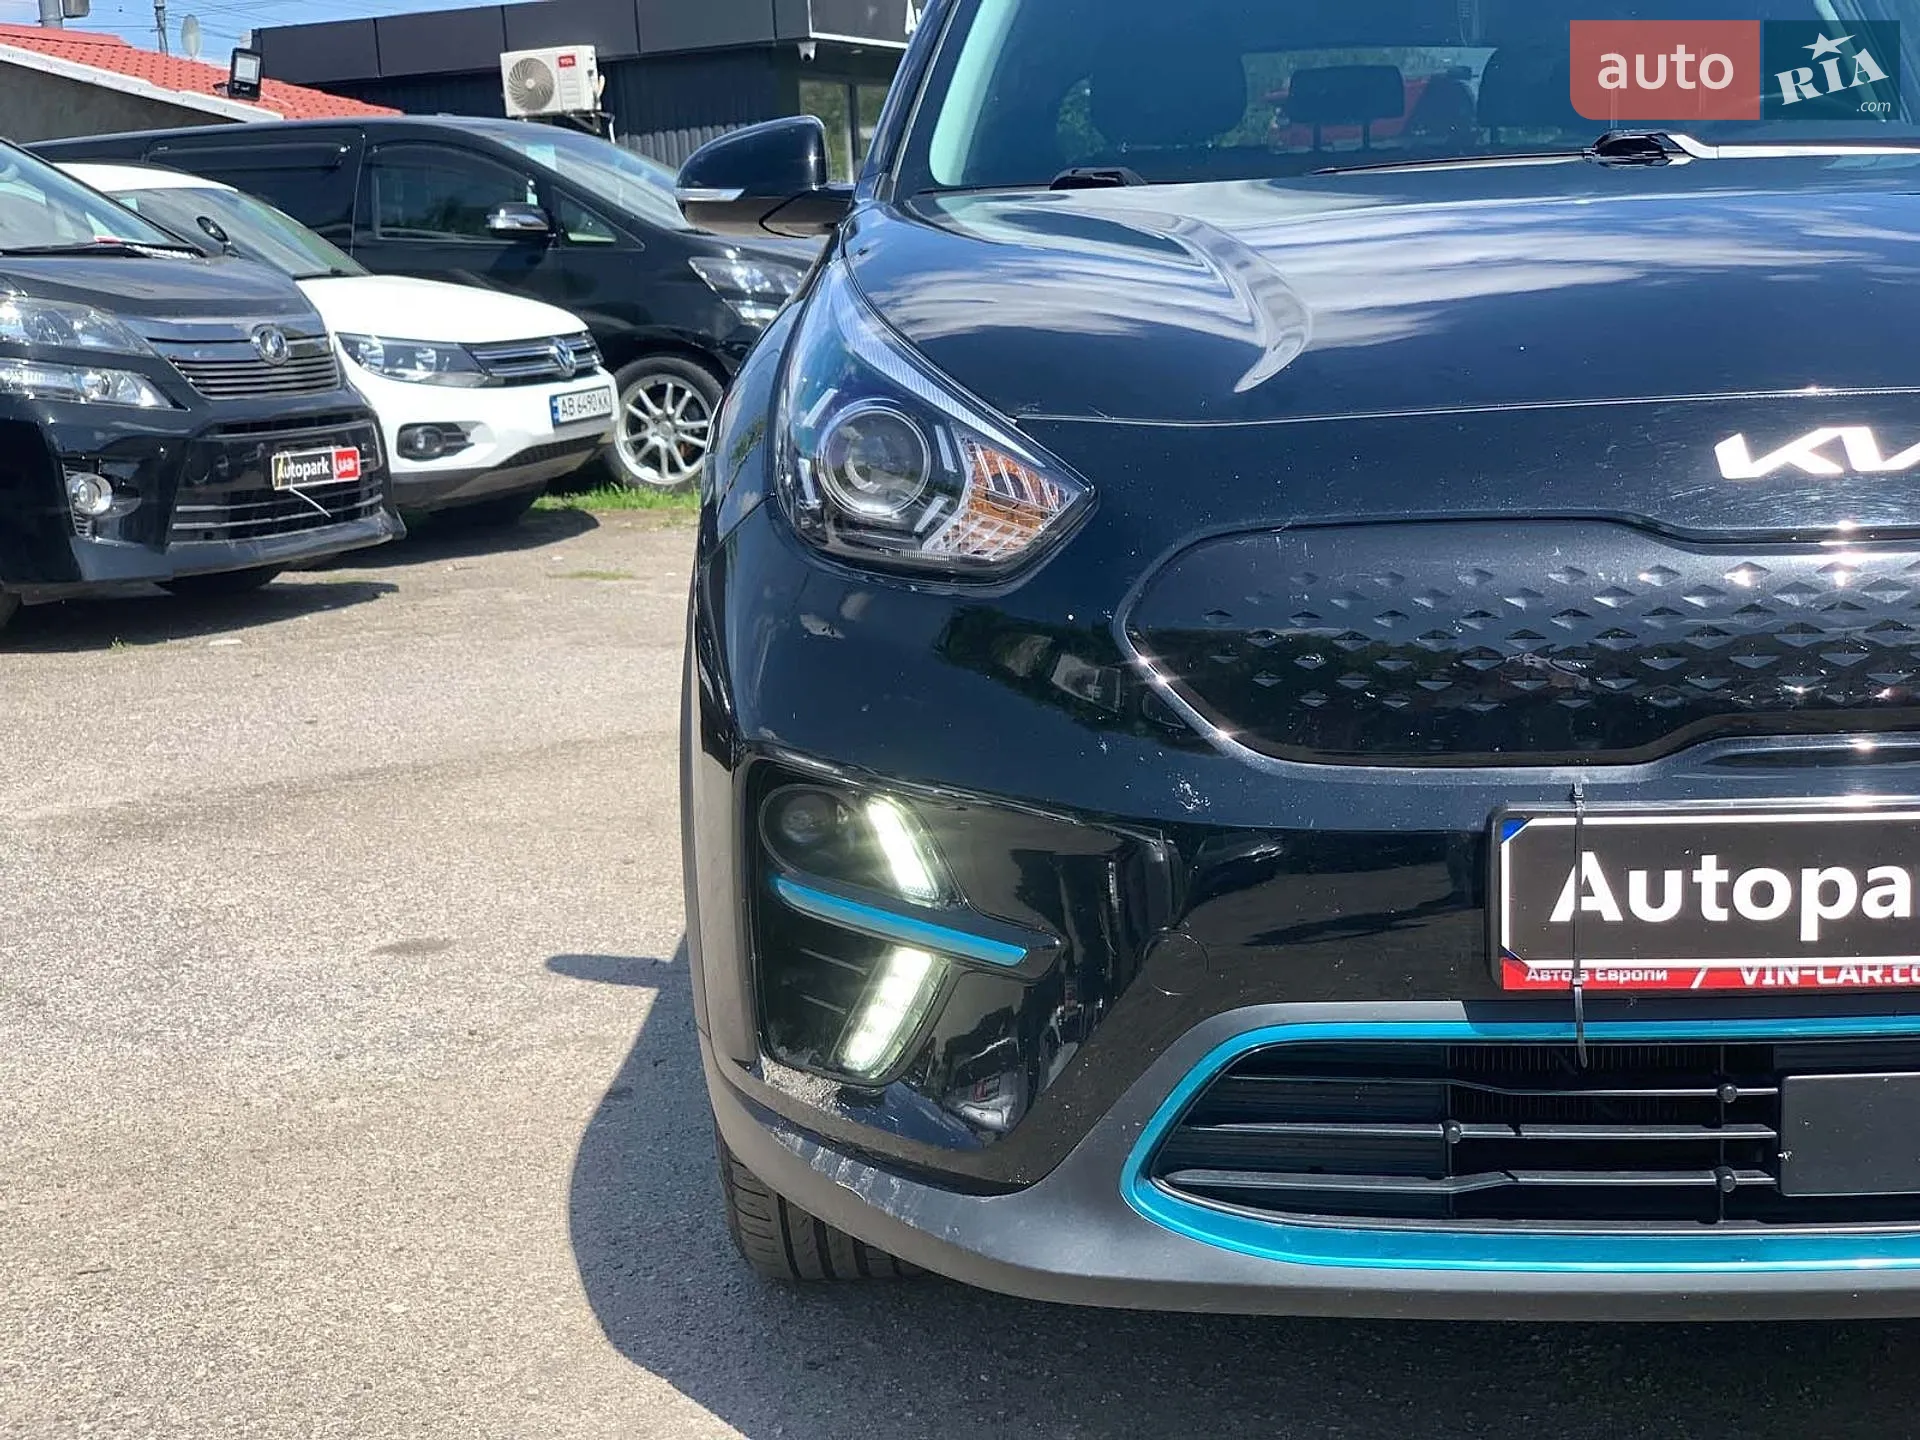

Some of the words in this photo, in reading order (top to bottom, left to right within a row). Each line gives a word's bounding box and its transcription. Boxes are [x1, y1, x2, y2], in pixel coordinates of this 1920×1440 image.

[277, 456, 330, 481] Autopark
[1549, 850, 1911, 941] Autopa
[1525, 968, 1574, 982] Авто
